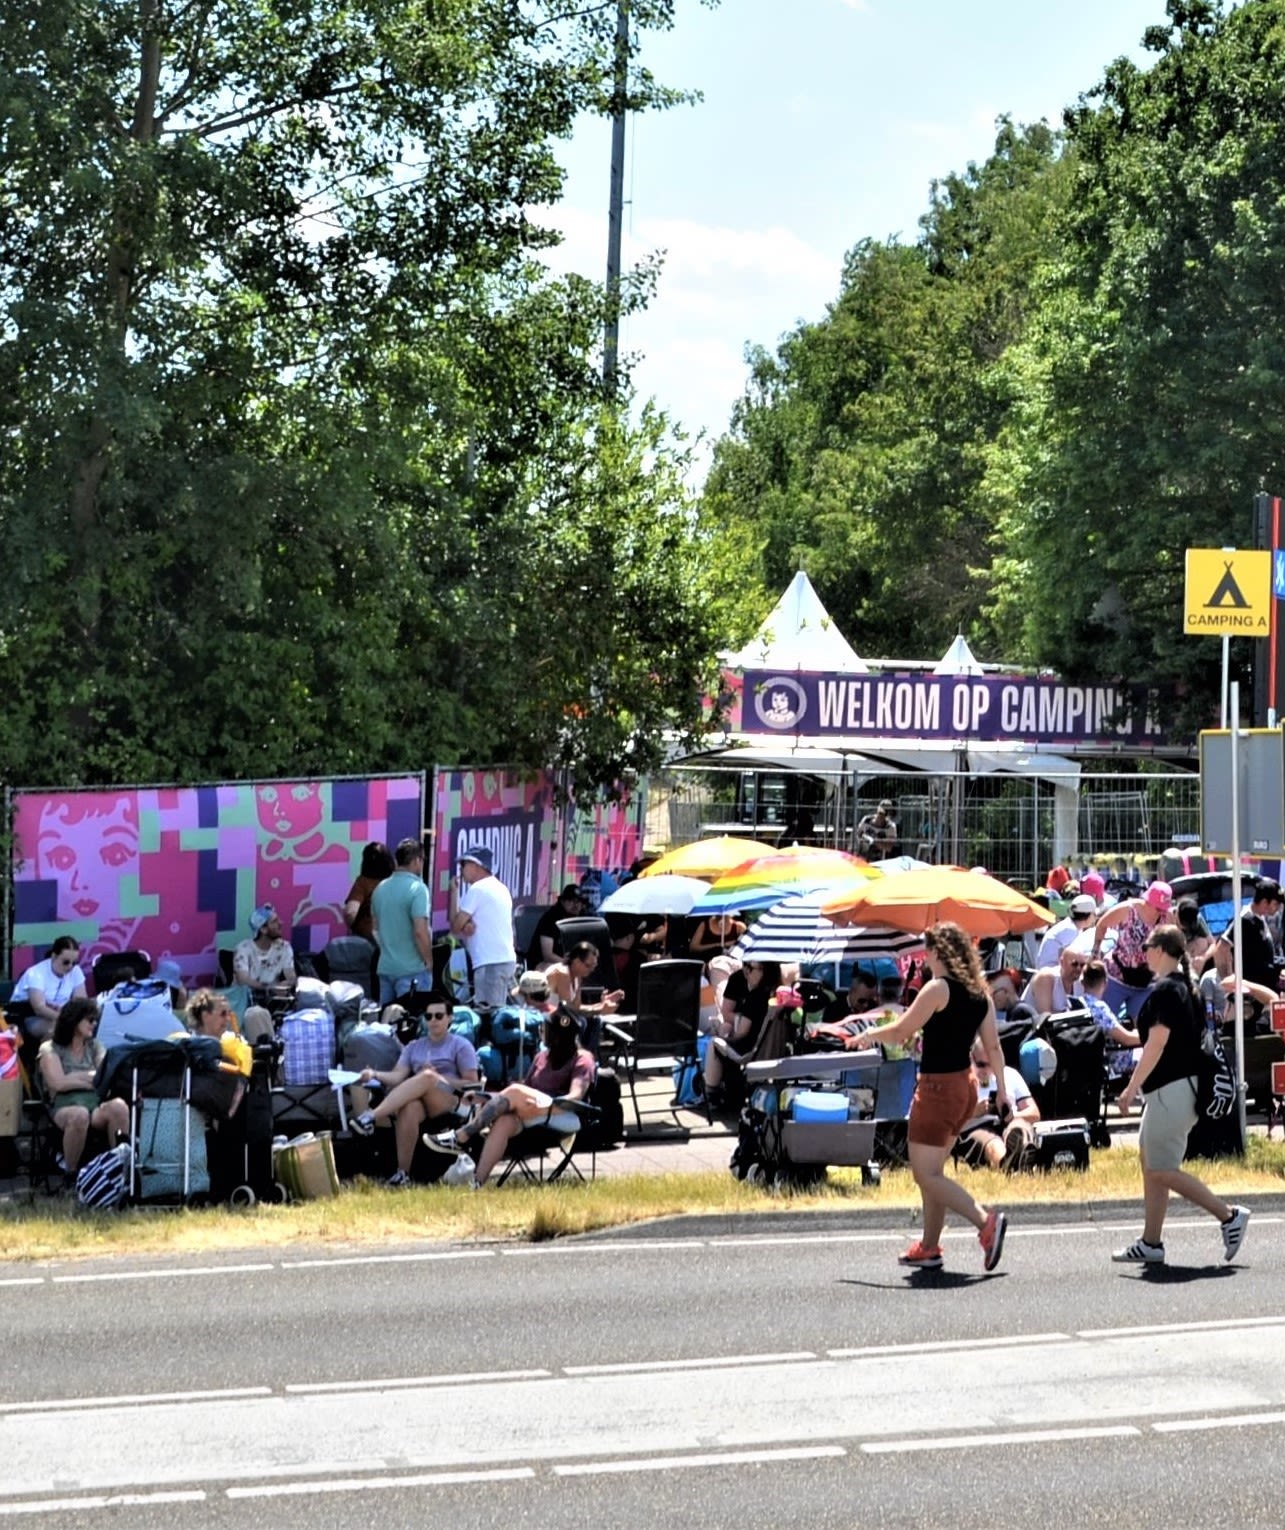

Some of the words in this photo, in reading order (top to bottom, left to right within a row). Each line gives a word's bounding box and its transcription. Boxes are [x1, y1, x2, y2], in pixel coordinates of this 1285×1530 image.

[1187, 614, 1253, 628] CAMPING
[1257, 615, 1267, 628] A
[818, 679, 940, 731] WELKOM
[953, 684, 989, 731] OP
[457, 824, 522, 908] CPING
[523, 823, 534, 897] A
